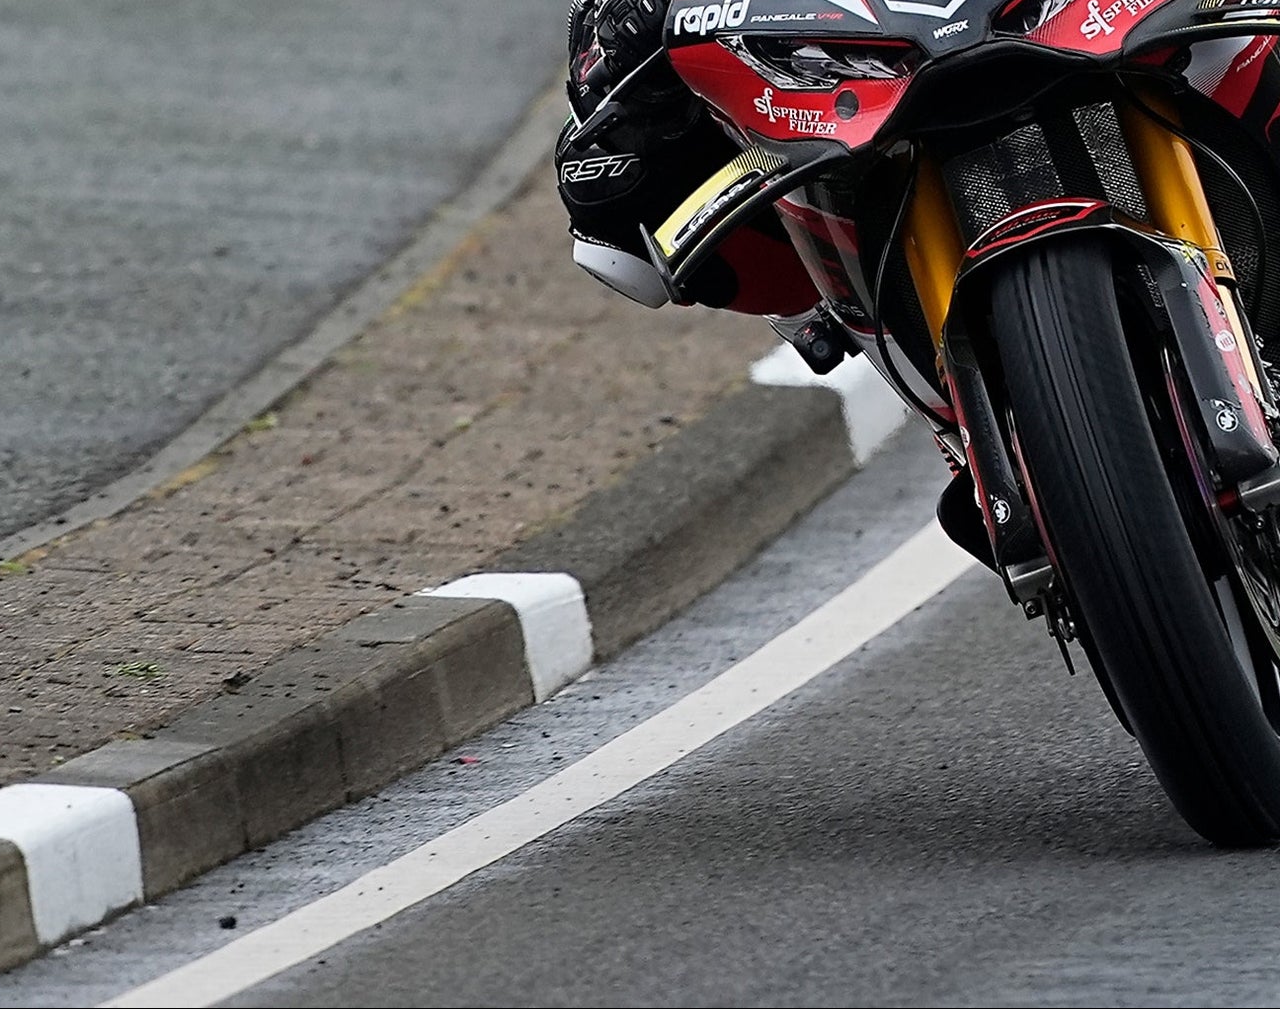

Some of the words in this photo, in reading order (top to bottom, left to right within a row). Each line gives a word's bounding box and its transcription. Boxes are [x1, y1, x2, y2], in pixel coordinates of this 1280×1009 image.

[772, 106, 823, 121] SPRINT
[789, 118, 837, 134] FILTER
[561, 153, 640, 183] RST
